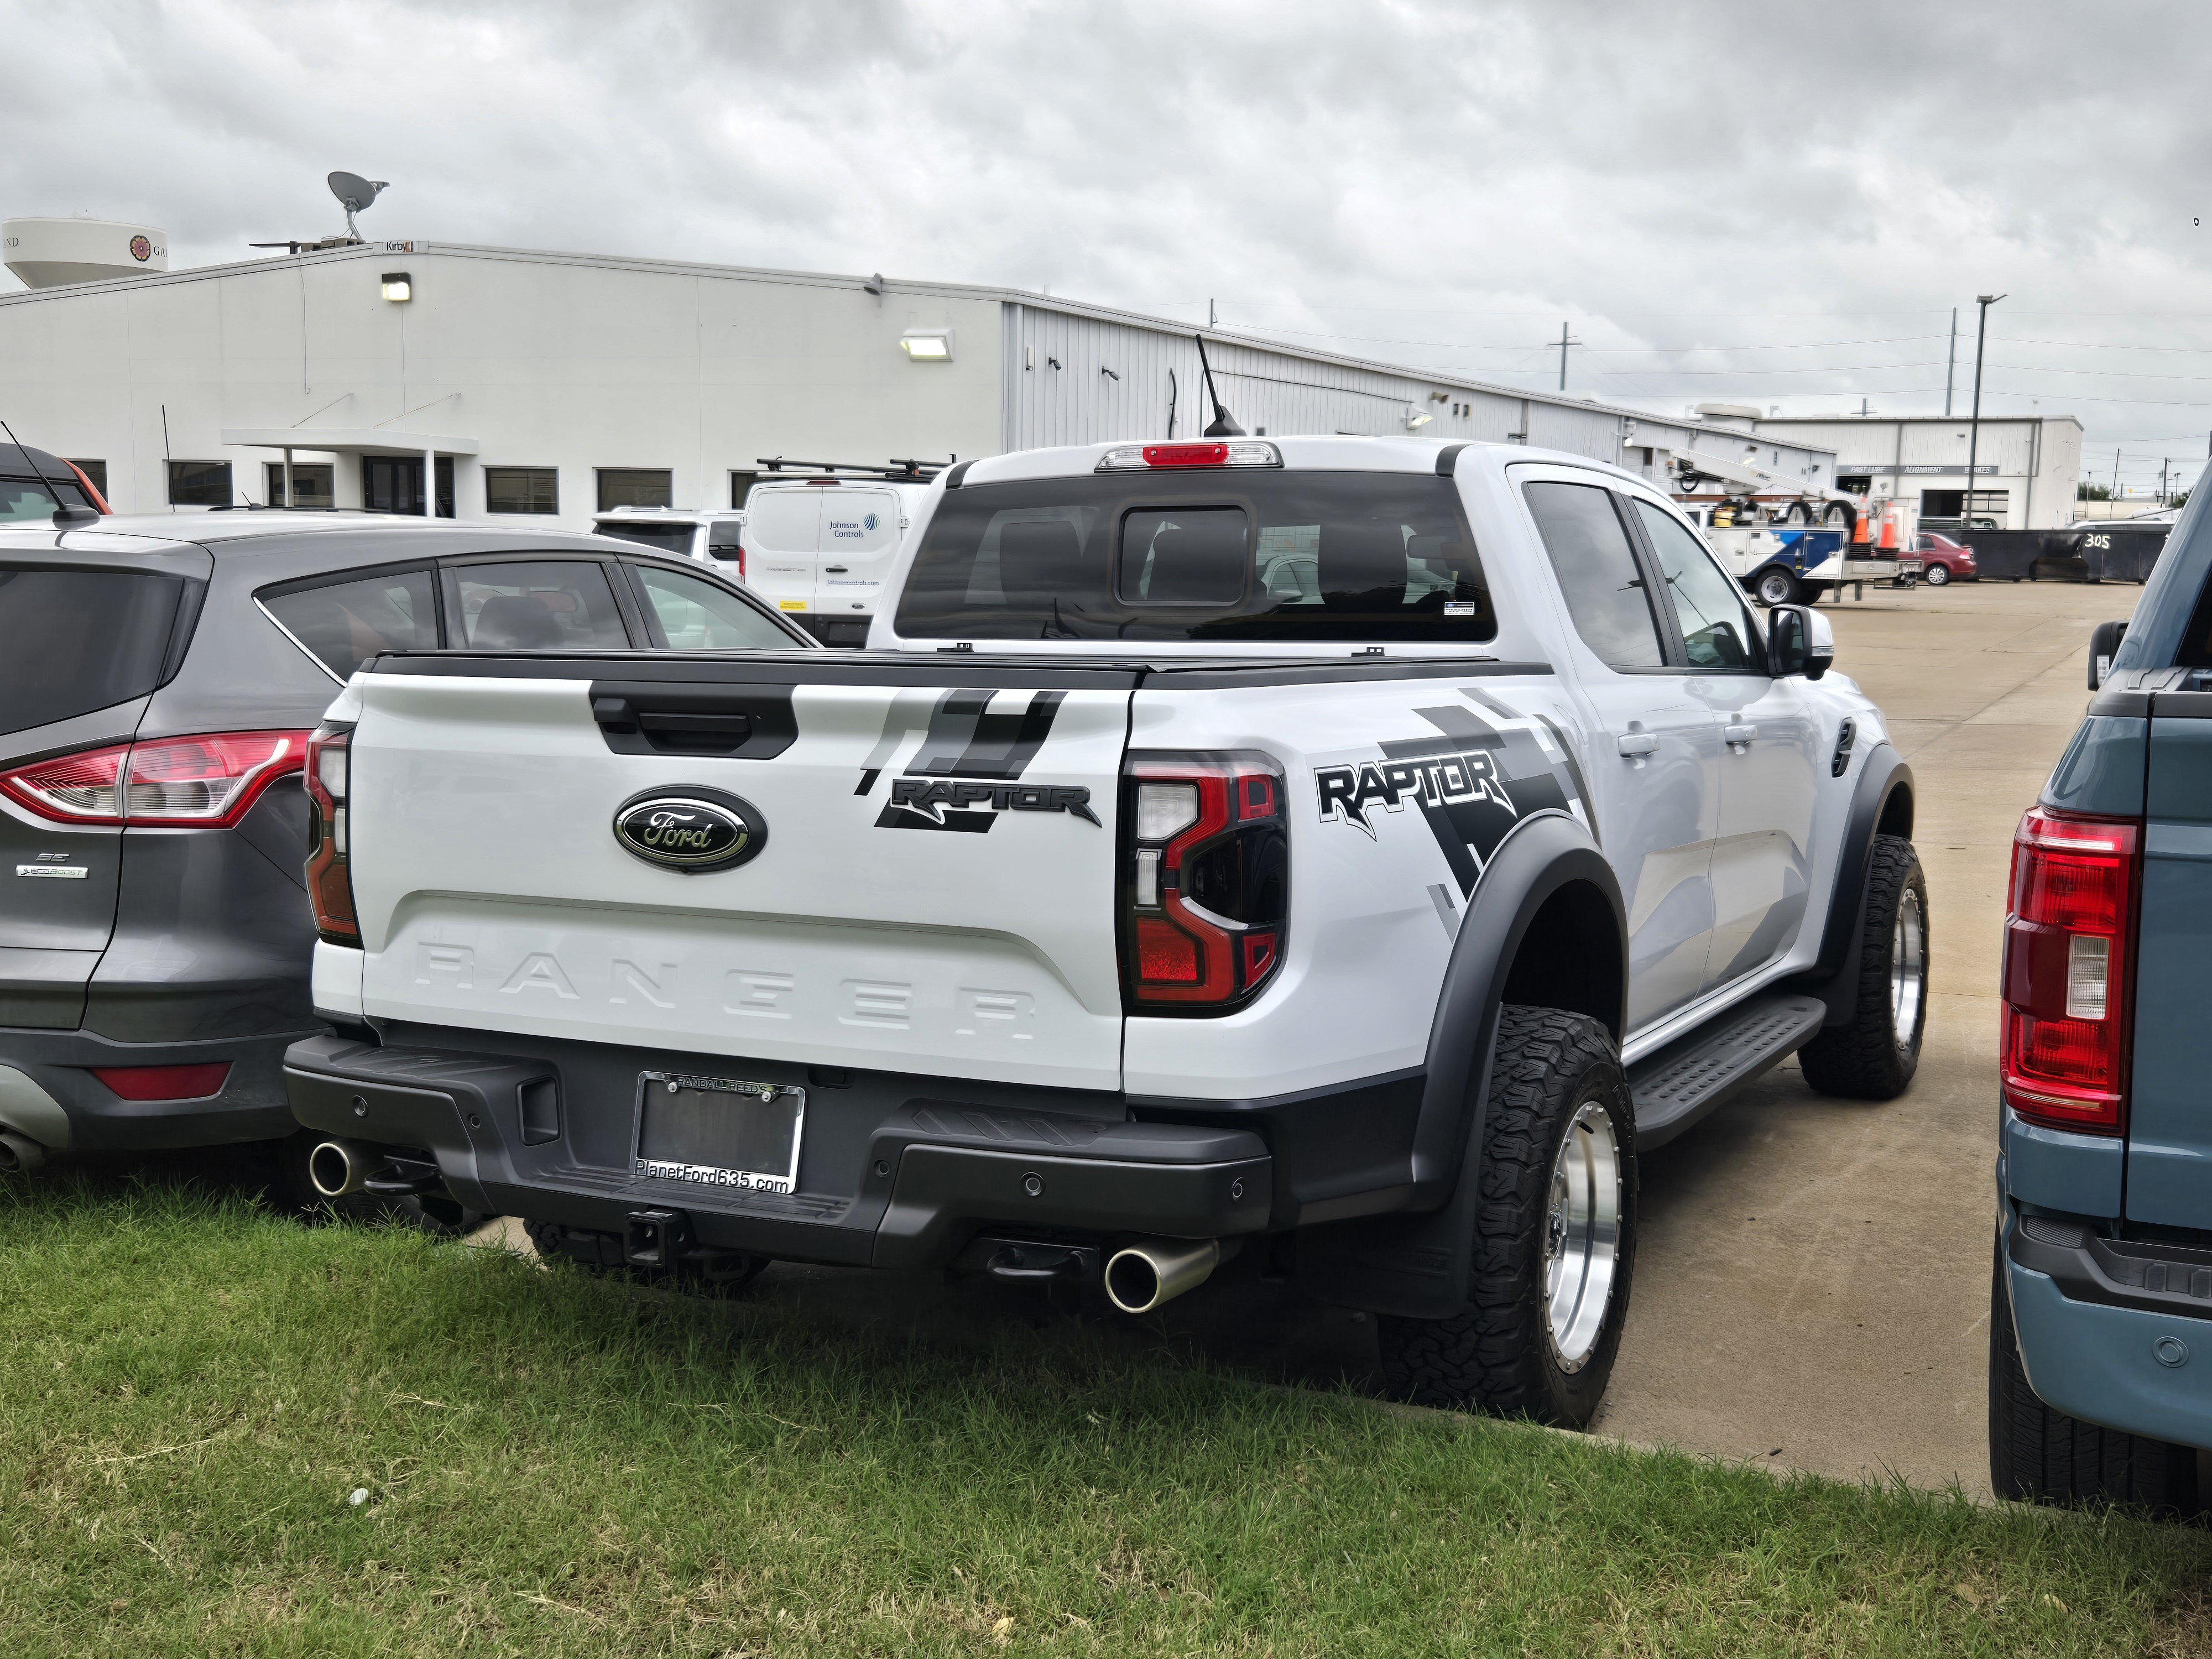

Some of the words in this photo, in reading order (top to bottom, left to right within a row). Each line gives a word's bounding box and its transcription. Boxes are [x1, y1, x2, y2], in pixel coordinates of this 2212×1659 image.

[154, 246, 167, 257] GA
[387, 241, 406, 252] Kirby
[2084, 534, 2111, 549] 305
[892, 779, 1102, 828] RAPTOR
[1313, 749, 1517, 842] RAPTOR
[644, 811, 713, 848] Ford
[416, 941, 1036, 1040] RANGER
[677, 1076, 727, 1089] RANDALL
[729, 1082, 768, 1093] REED'S
[635, 1159, 789, 1193] PlanetFord635.com
